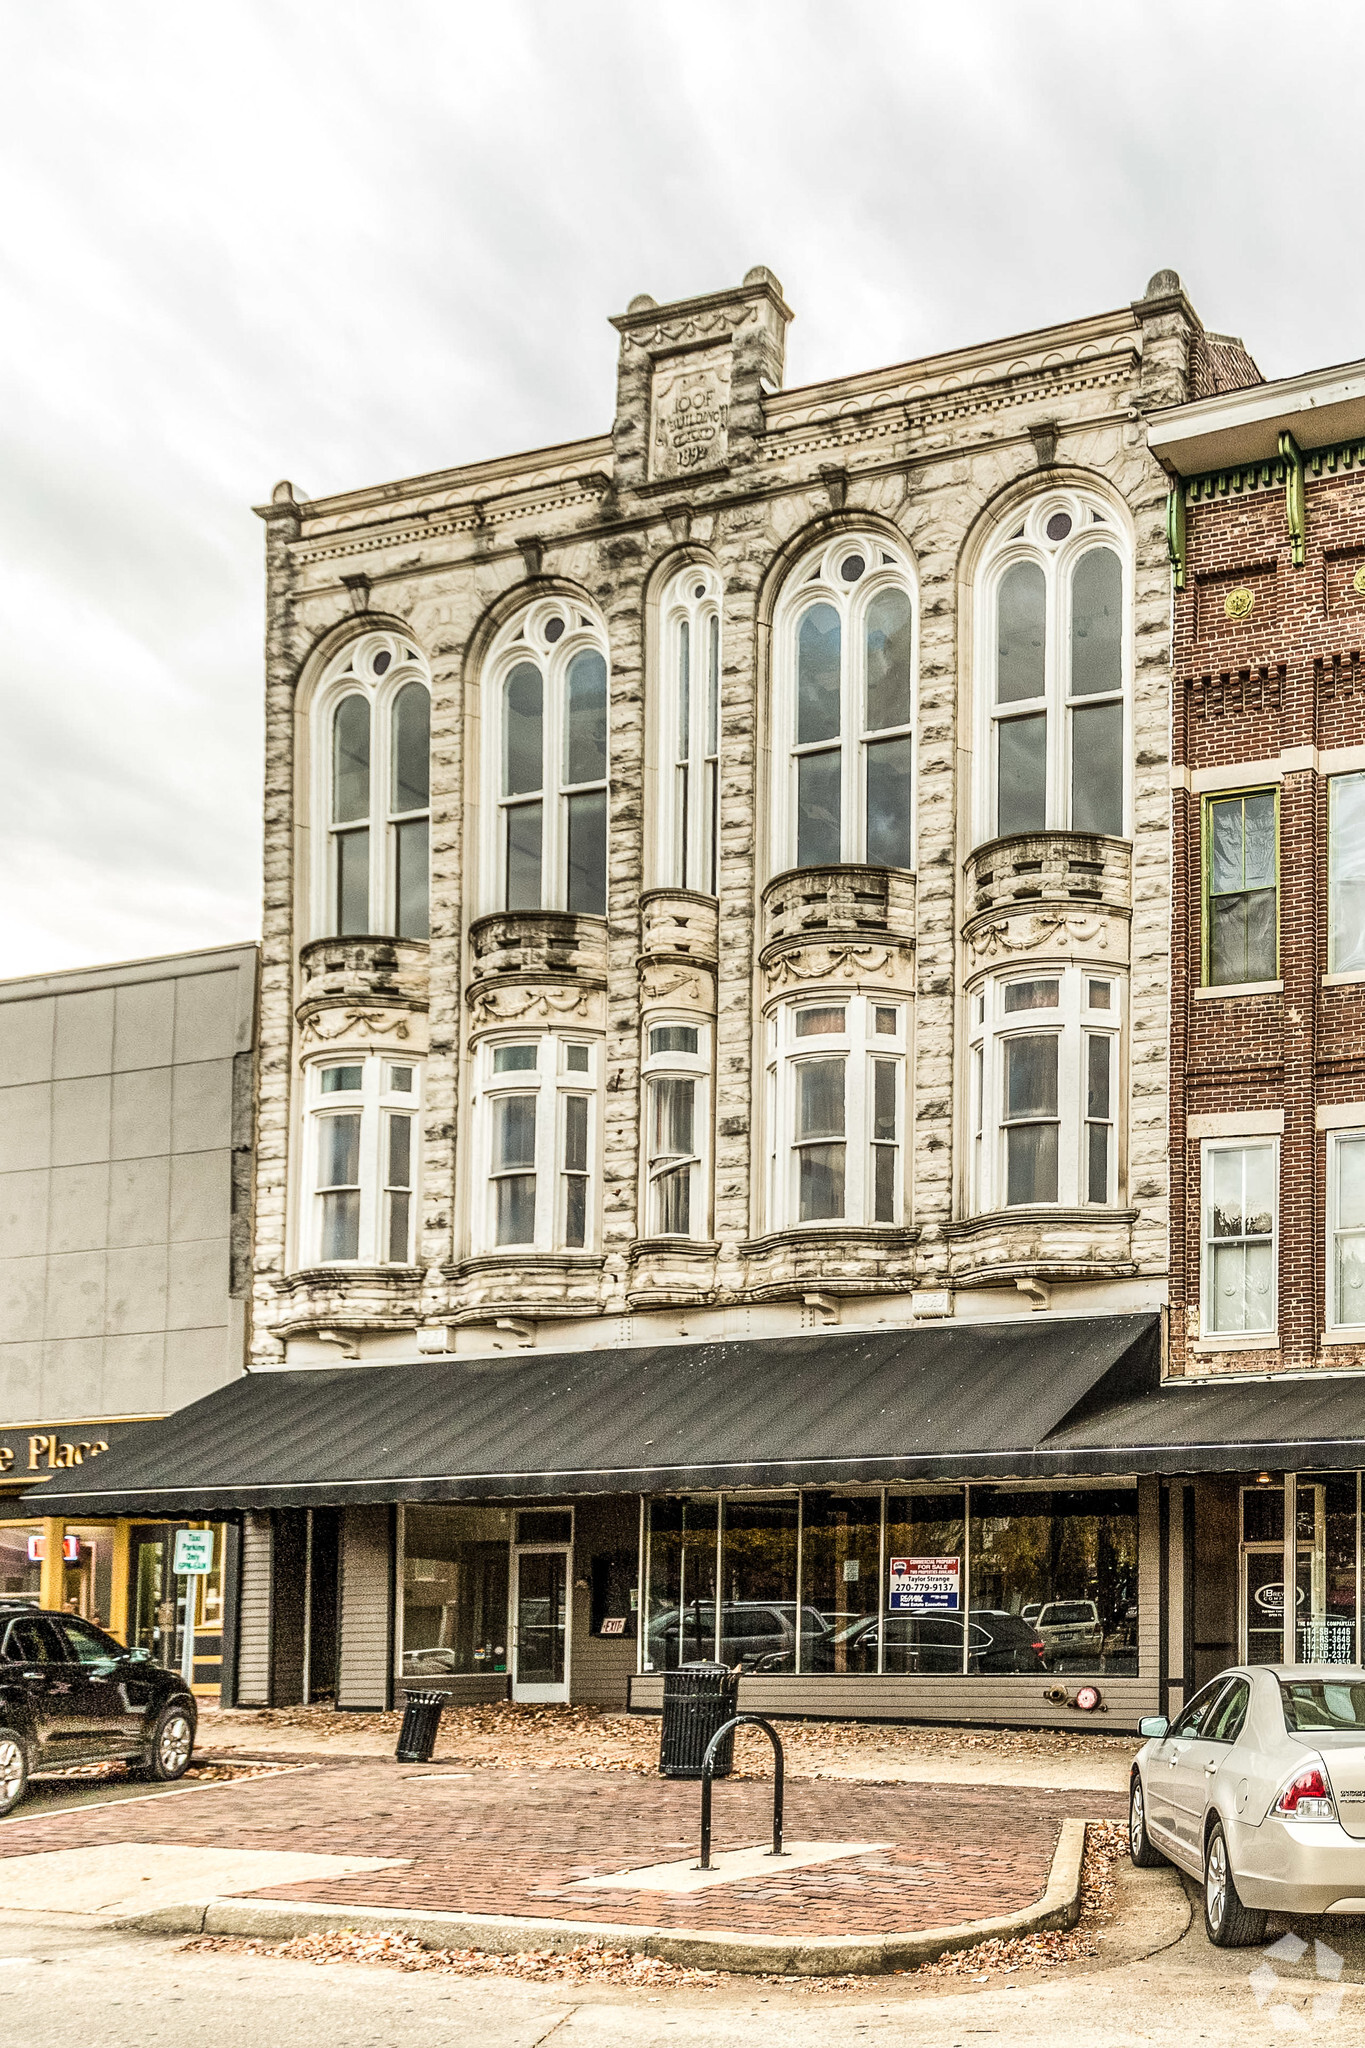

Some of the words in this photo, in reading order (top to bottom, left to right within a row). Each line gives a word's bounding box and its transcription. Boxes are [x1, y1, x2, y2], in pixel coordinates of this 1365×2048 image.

[676, 446, 708, 467] 1892
[182, 1543, 206, 1553] Parking
[187, 1553, 200, 1563] Only
[895, 1583, 953, 1591] 270-779-9137
[604, 1620, 622, 1632] EXIT
[1302, 1643, 1351, 1651] 114-SB-1447
[1302, 1651, 1351, 1659] 114-LD-2377
